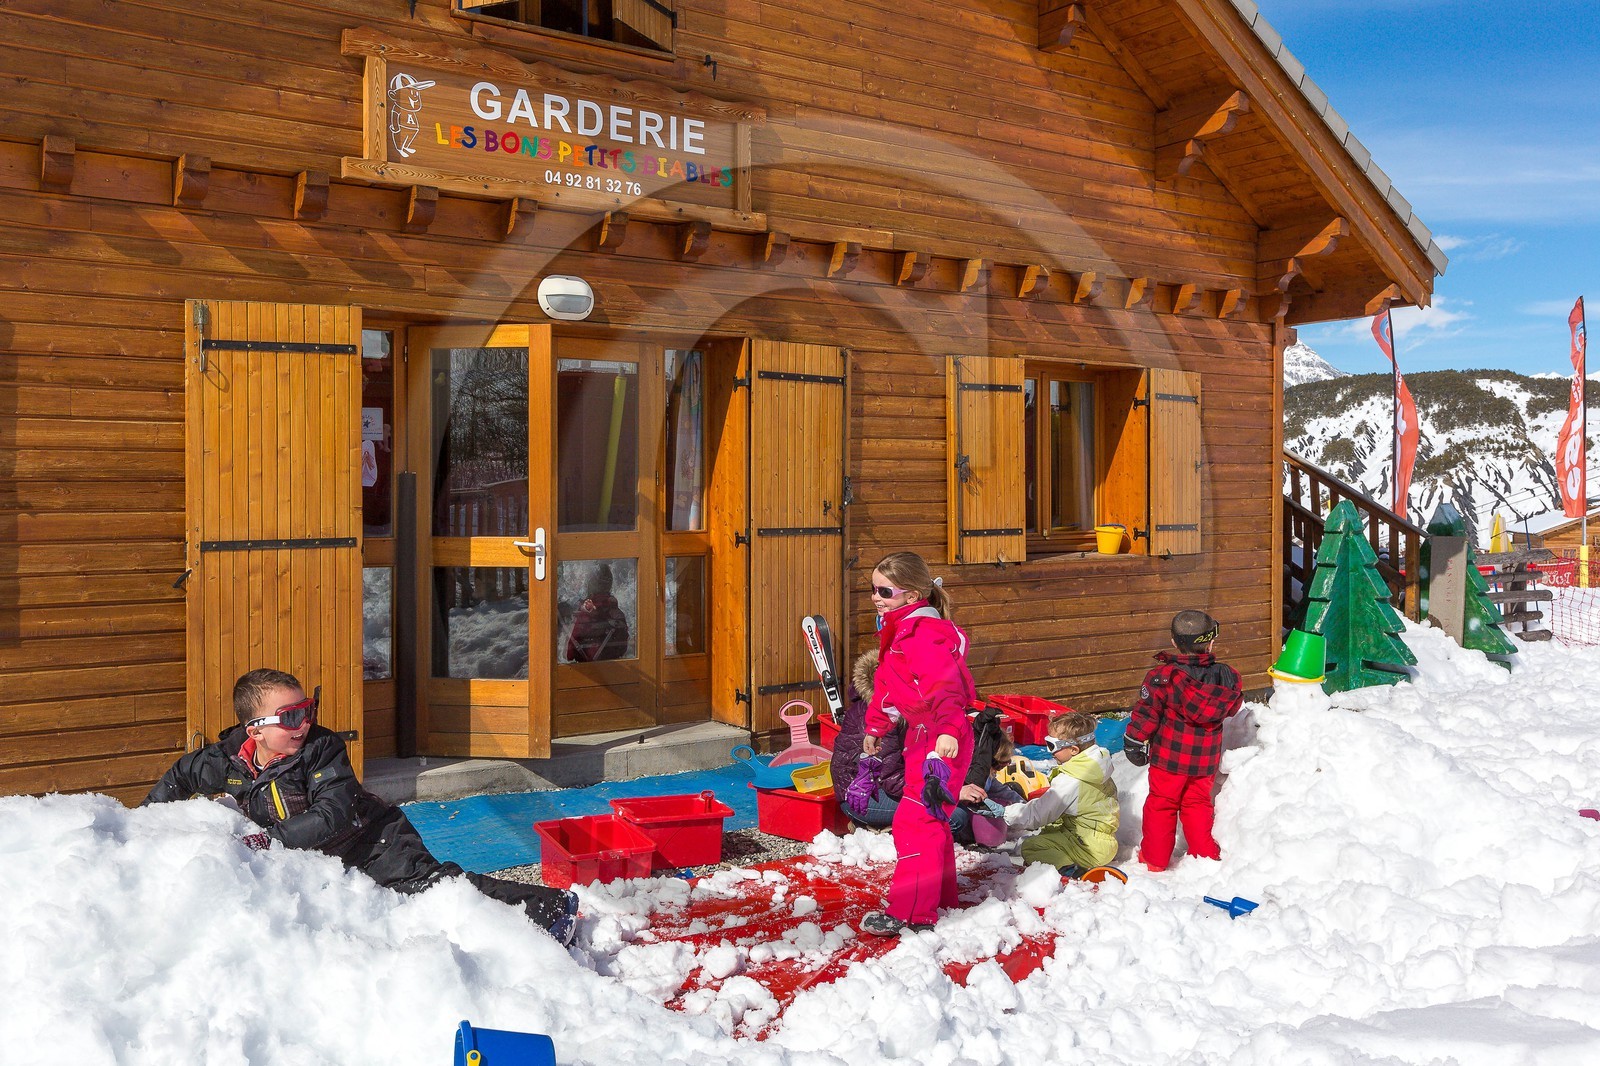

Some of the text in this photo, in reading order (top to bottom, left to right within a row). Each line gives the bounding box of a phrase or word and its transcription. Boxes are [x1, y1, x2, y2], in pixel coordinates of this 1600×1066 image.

[406, 113, 416, 125] A
[469, 81, 706, 155] GARDERIE
[435, 122, 734, 188] LES BONS PETITS DIABLES
[544, 169, 642, 196] 04 92 81 32 76
[807, 624, 820, 655] HEAD
